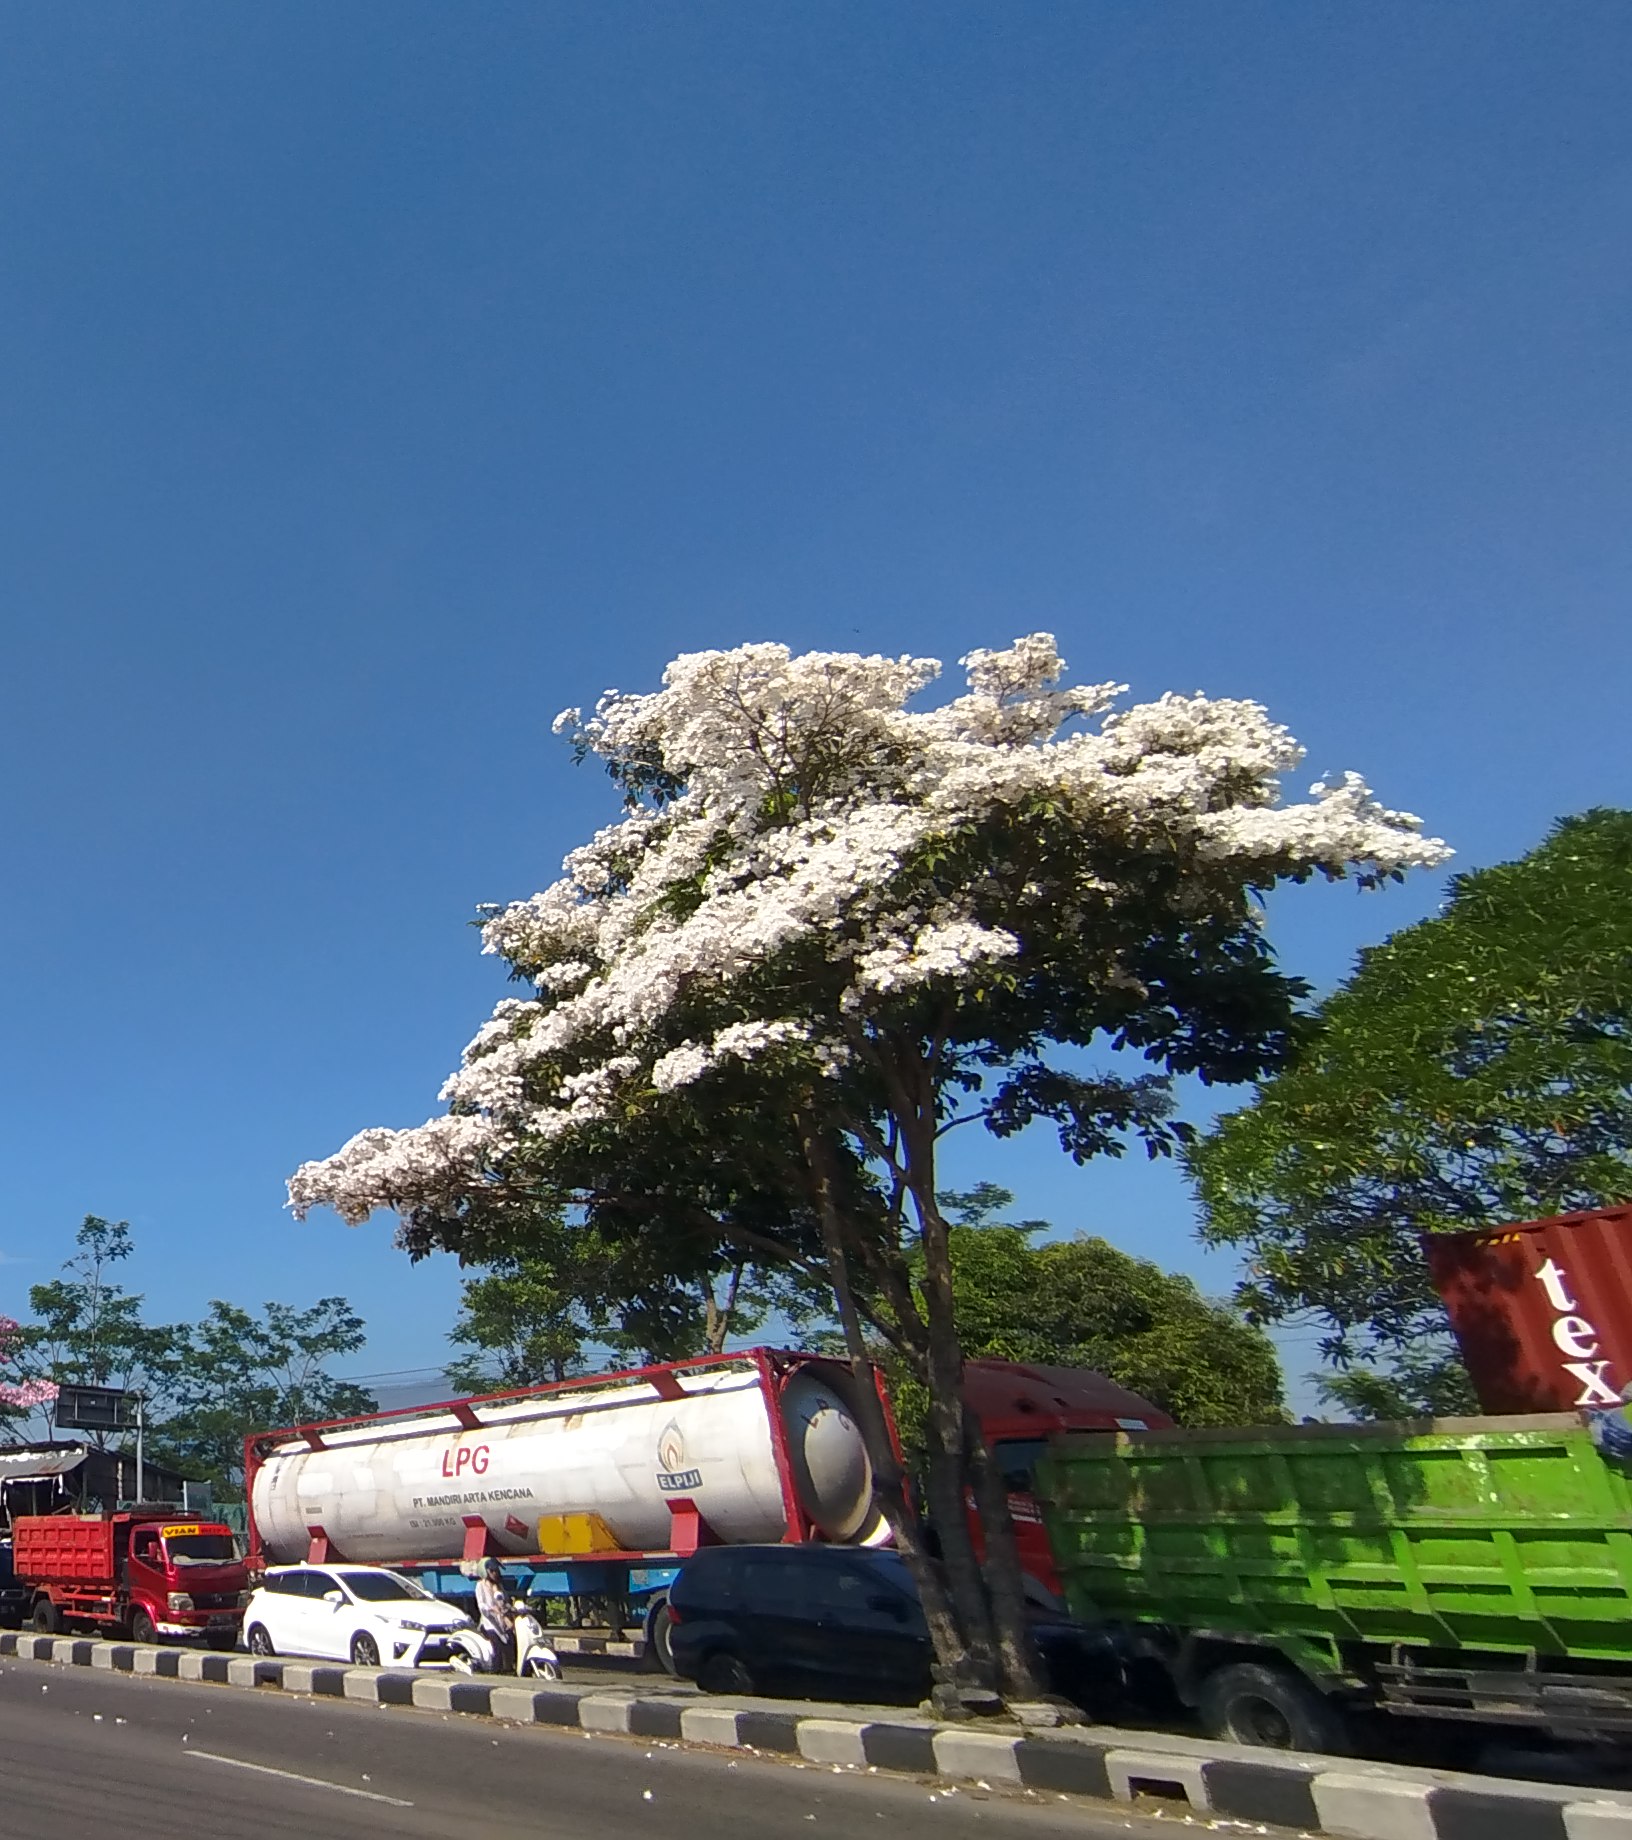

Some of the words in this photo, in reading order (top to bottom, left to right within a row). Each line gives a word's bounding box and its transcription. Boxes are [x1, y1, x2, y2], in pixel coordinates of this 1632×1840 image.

[1534, 1258, 1622, 1405] tex
[442, 1445, 490, 1477] LPG
[659, 1472, 700, 1488] ELPIJI
[413, 1497, 427, 1508] PT.
[426, 1494, 463, 1506] MANDIRI
[463, 1491, 488, 1504] ARTA
[487, 1487, 534, 1501] KENCANA
[165, 1527, 196, 1536] VIAN
